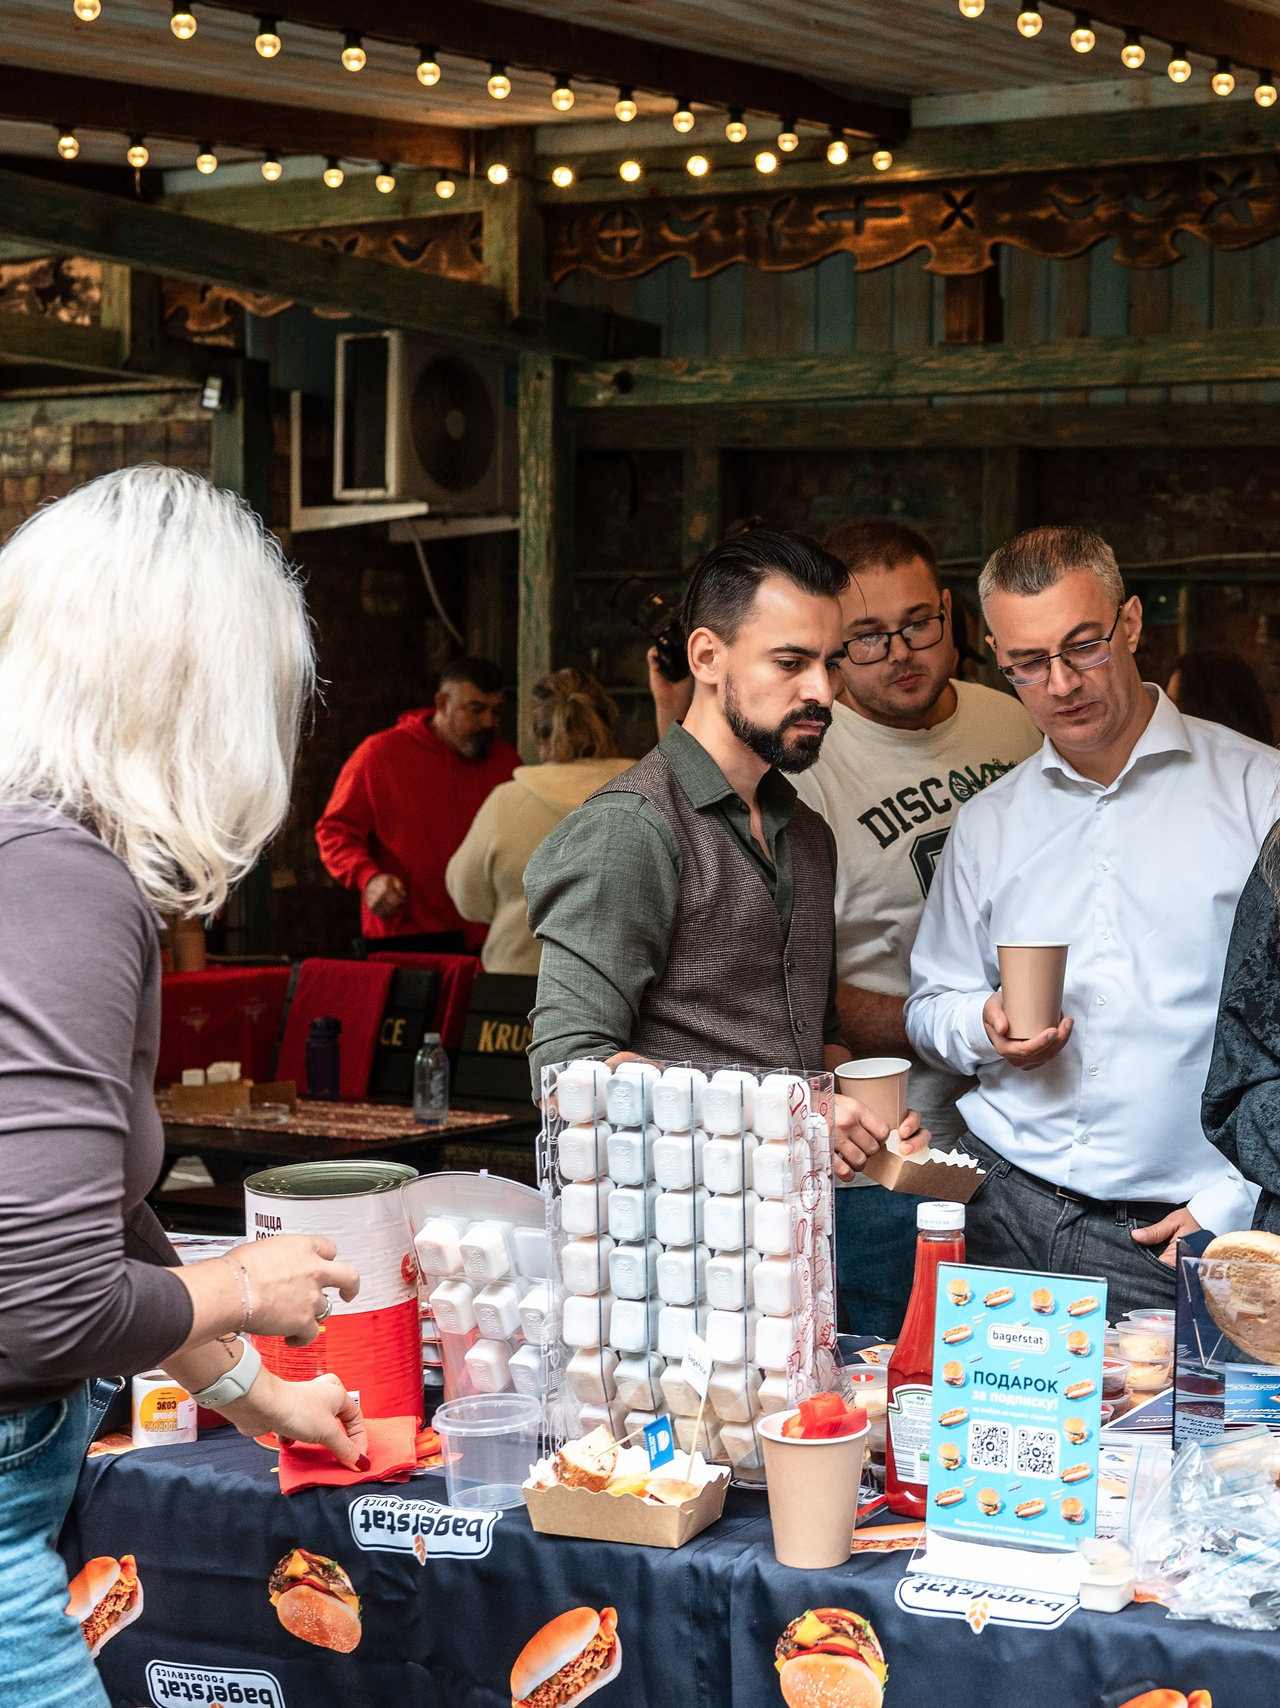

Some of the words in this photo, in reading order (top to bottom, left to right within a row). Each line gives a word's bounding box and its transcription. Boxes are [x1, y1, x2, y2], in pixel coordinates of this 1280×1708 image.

[477, 1019, 533, 1053] KRU
[254, 1212, 283, 1231] ПИЦЦА
[992, 1329, 1044, 1346] bagerstat
[973, 1370, 1059, 1394] ПОДАРОК
[156, 1400, 177, 1411] СОУС
[971, 1389, 987, 1401] за
[990, 1392, 1059, 1411] подписку!
[362, 1498, 442, 1514] FOODSERVICE
[359, 1509, 484, 1543] bagerstat
[155, 1668, 224, 1684] FOODSERVICE
[157, 1678, 276, 1708] bagerstat
